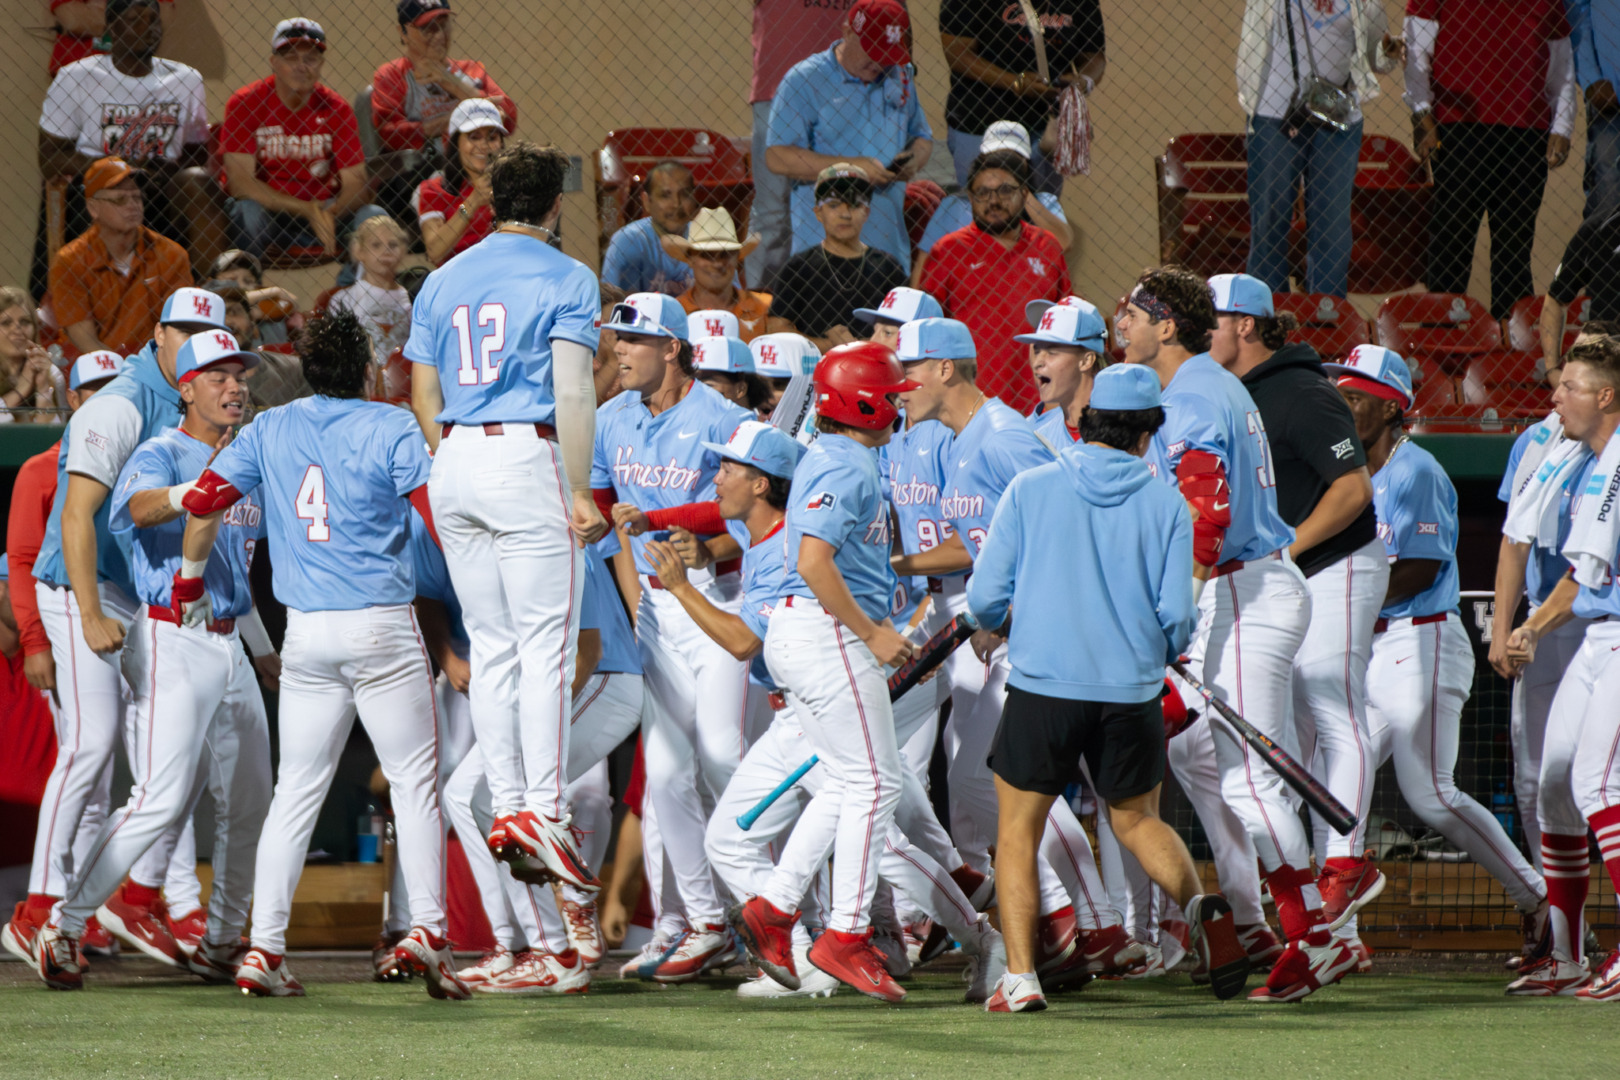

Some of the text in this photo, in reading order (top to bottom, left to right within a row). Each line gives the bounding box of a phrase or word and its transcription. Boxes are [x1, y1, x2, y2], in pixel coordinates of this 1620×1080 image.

[193, 295, 212, 317] UH
[705, 319, 725, 336] UH
[214, 332, 236, 351] UH
[452, 303, 507, 385] 12
[94, 353, 117, 370] UH
[760, 344, 778, 365] UH
[613, 444, 702, 493] Huston
[295, 464, 330, 542] 4
